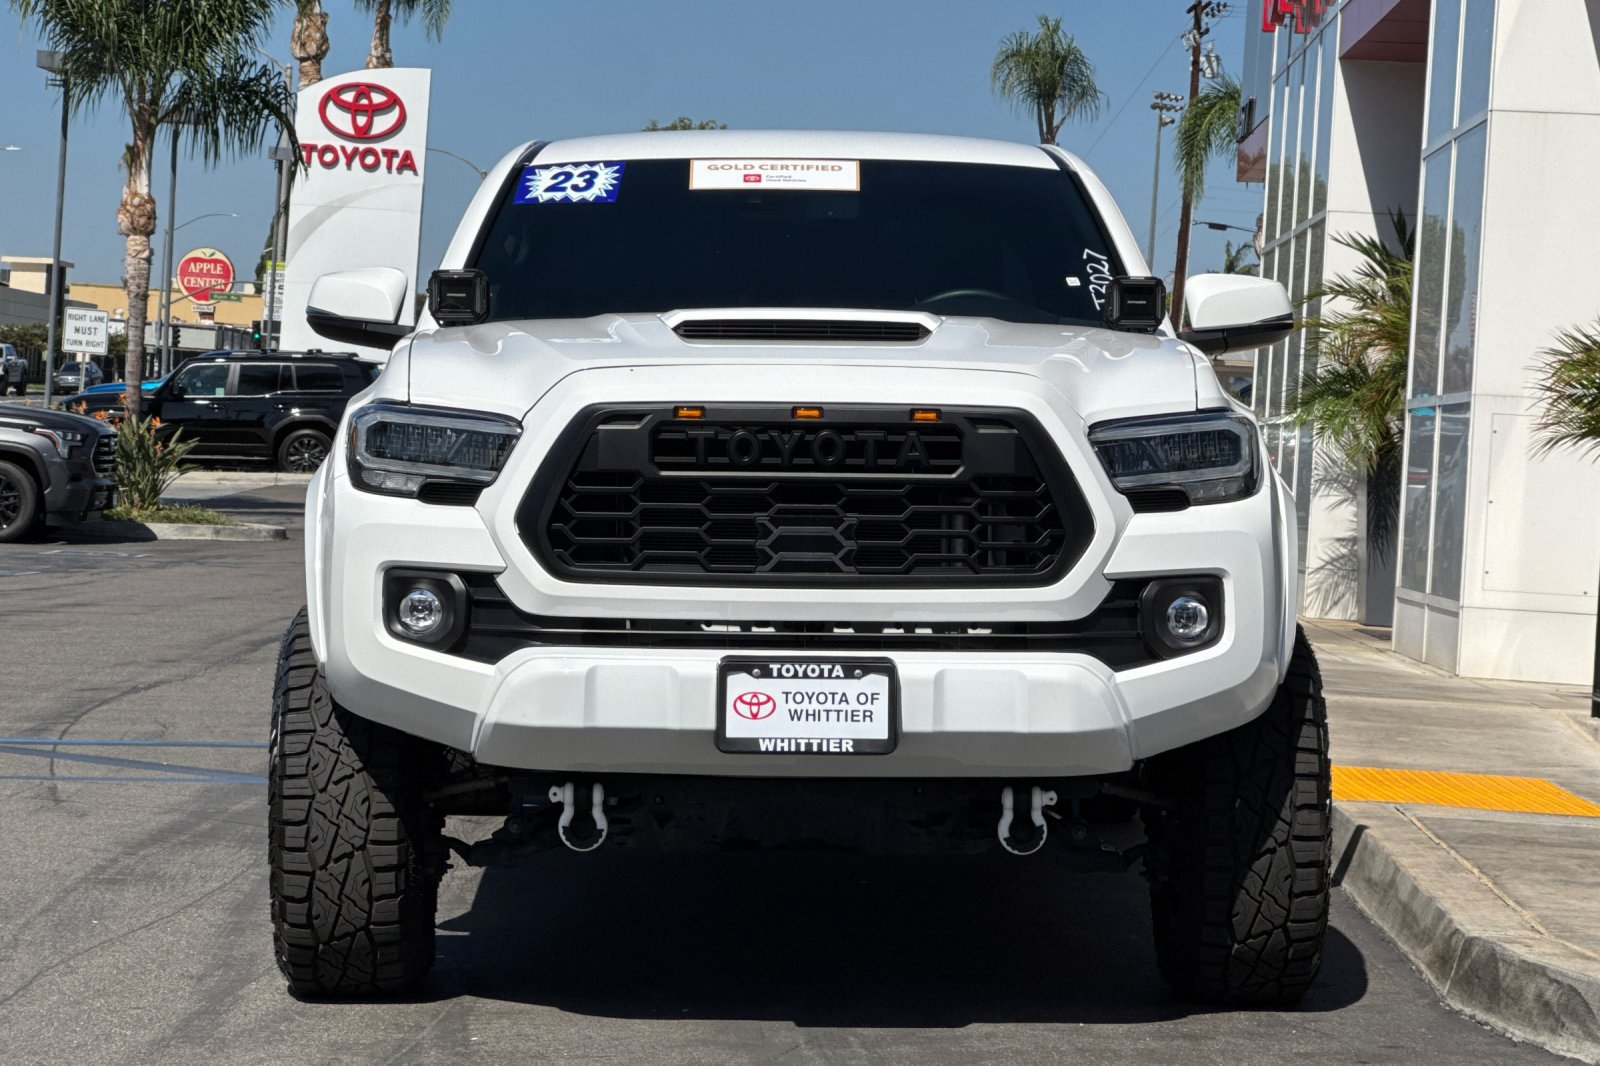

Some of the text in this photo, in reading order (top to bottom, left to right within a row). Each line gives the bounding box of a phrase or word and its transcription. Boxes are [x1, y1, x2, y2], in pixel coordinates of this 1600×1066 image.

[300, 143, 417, 174] TOYOTA
[758, 164, 843, 172] CERTIFIED
[543, 170, 599, 193] 23
[188, 262, 224, 275] APPLE
[183, 276, 225, 290] CENTER
[67, 313, 106, 323] RIGHT LANE
[74, 325, 98, 336] MUST
[66, 338, 105, 348] TURN RIGHT
[686, 428, 930, 468] TOYOTA
[769, 664, 844, 678] TOYOTA
[782, 691, 880, 706] TOYOTA OF
[788, 708, 873, 723] WHITTIER
[758, 738, 854, 752] WHITTIER
